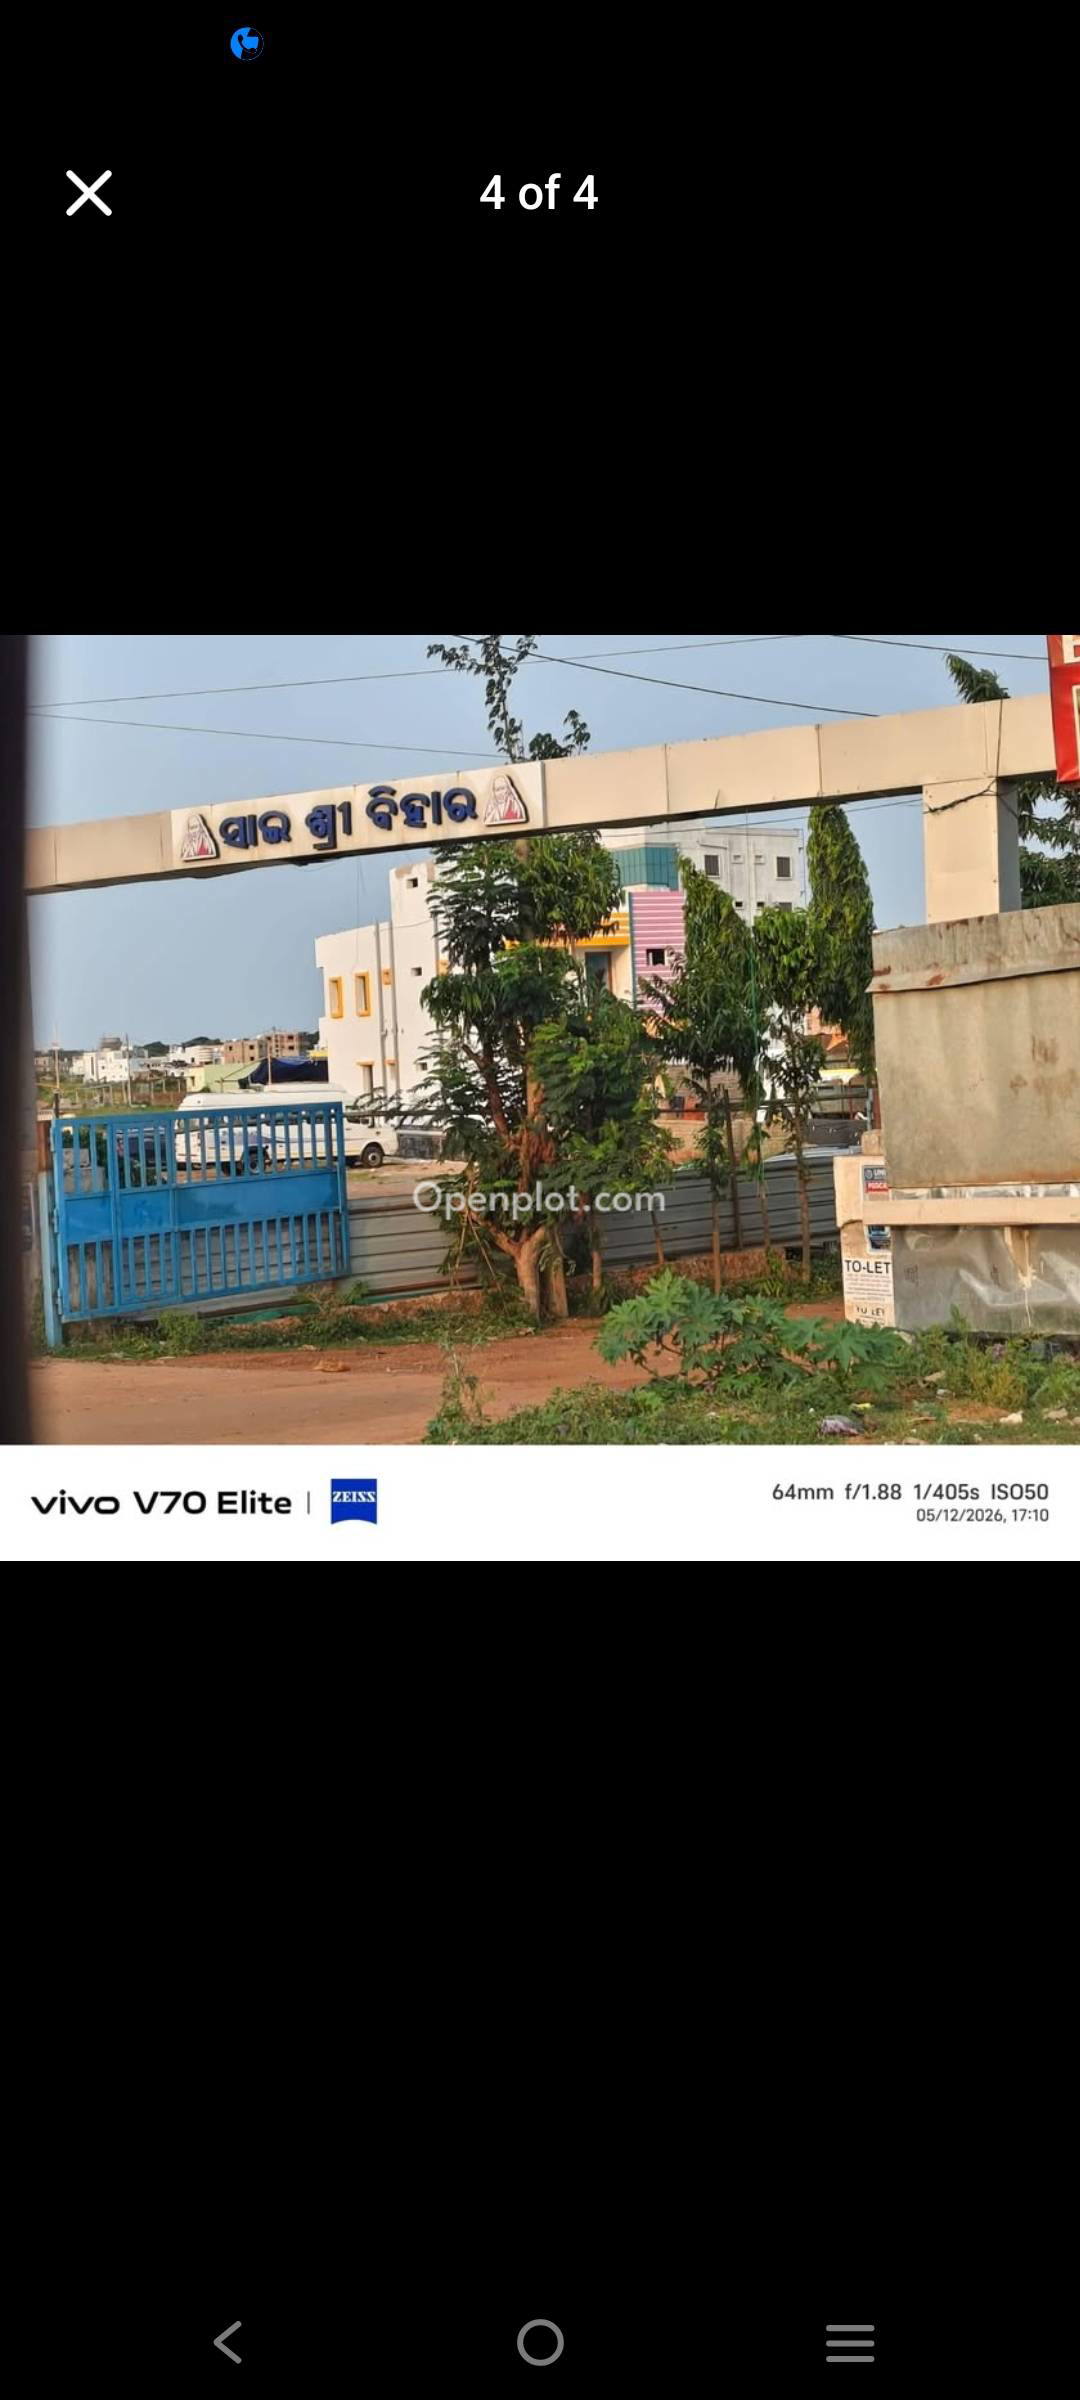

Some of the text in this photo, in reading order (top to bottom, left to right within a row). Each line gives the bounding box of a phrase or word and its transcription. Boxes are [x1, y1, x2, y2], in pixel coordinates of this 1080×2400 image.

[305, 800, 352, 850] ଶ୍ରୀ
[365, 785, 478, 830] ବିହାର
[844, 1259, 891, 1274] TO-LET
